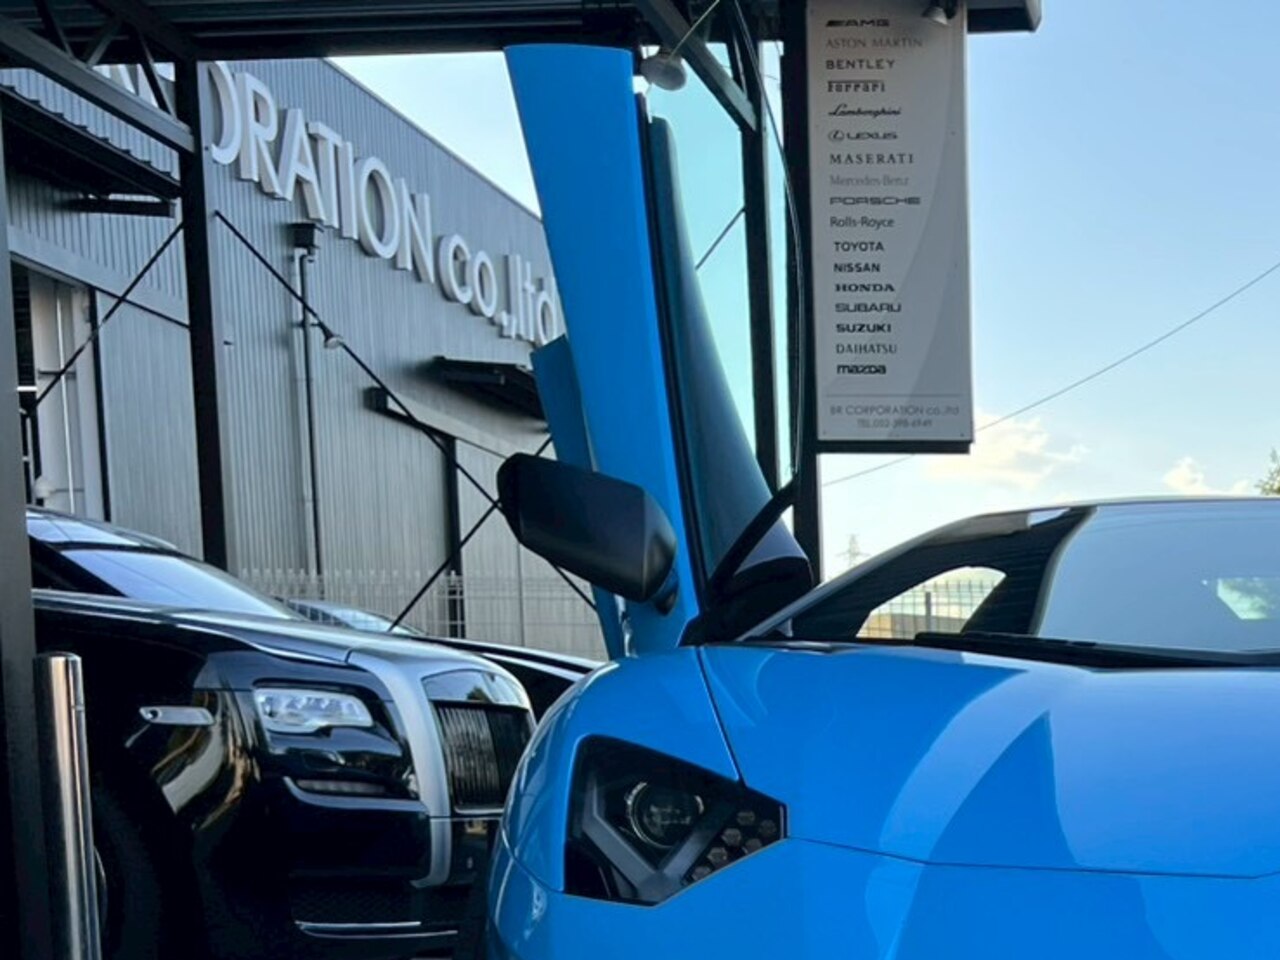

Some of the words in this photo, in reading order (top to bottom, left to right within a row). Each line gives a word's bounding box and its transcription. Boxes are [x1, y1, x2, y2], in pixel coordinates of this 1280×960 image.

[825, 38, 866, 48] ASTON
[871, 37, 923, 47] MARTIN
[825, 59, 895, 70] BENTLEY
[827, 80, 885, 92] Ferrari
[828, 103, 901, 118] Lamborghini
[847, 132, 898, 140] LEXUS
[829, 154, 914, 164] MASERATI
[829, 197, 921, 205] PORSCHE
[830, 216, 894, 230] Rolls-Royce
[833, 242, 884, 251] TOYOTA
[833, 263, 880, 273] NISSAN
[835, 284, 895, 292] HONDA
[835, 303, 901, 312] SUBARU
[836, 323, 892, 333] SUZUKI
[836, 344, 897, 354] DAIHATSU
[844, 405, 924, 416] CORPORATION
